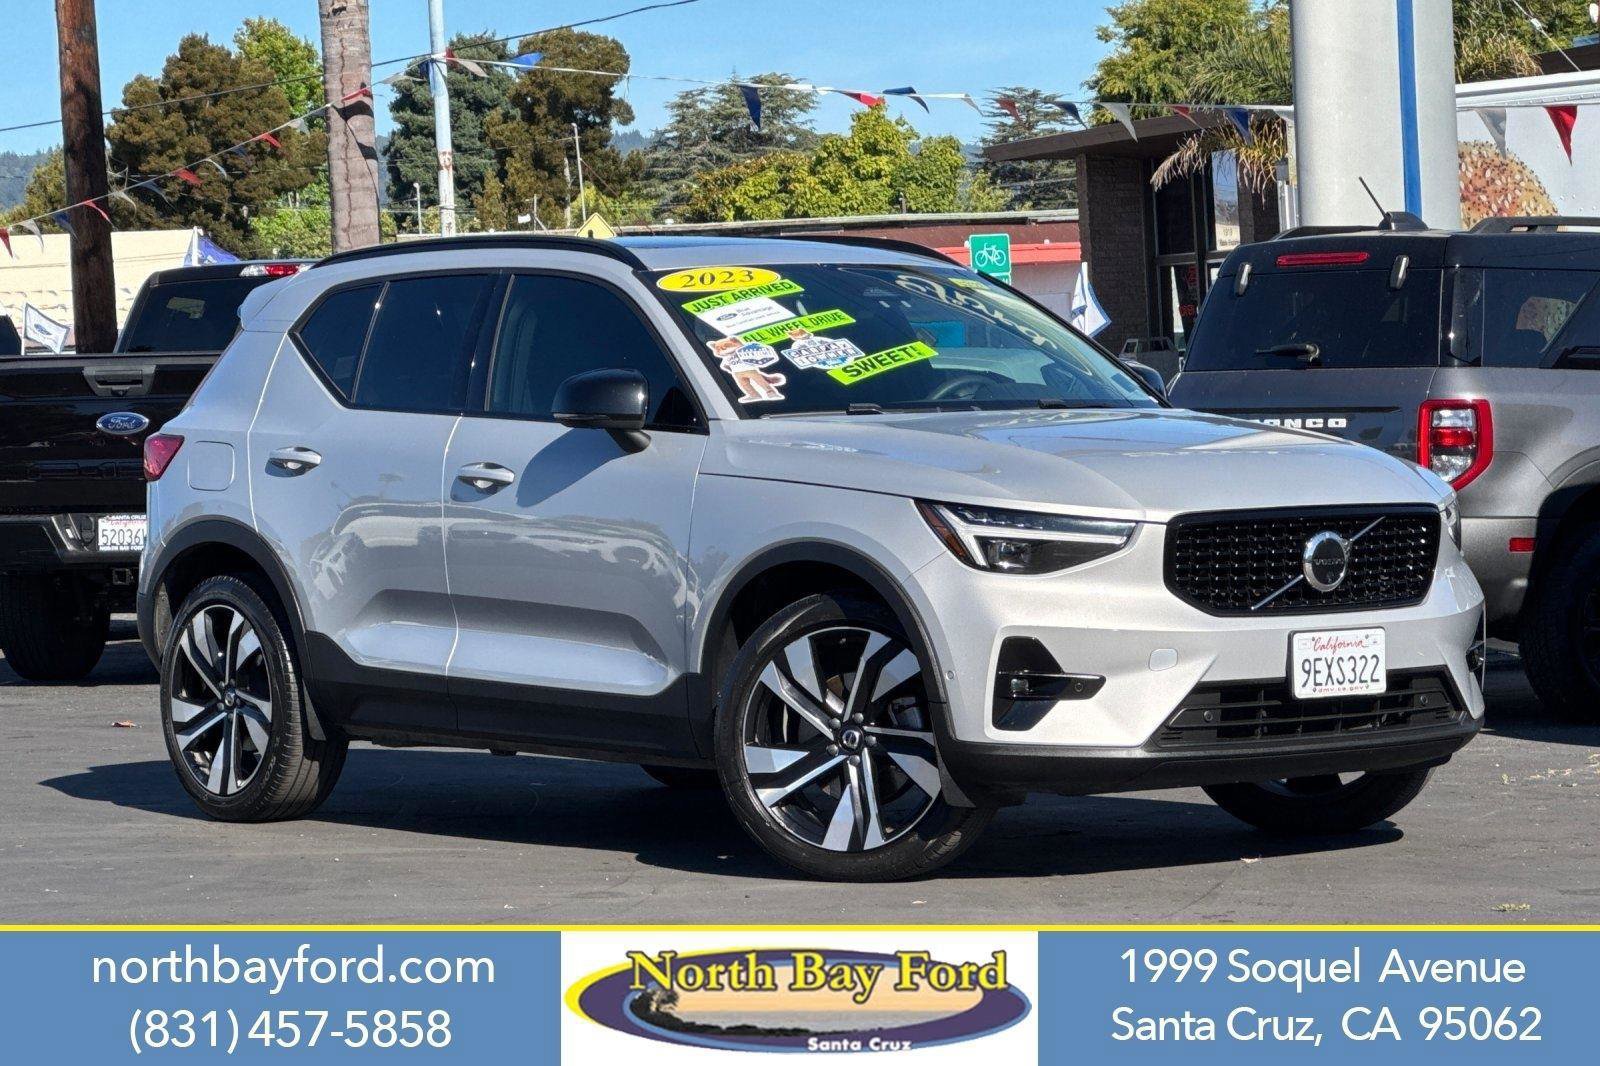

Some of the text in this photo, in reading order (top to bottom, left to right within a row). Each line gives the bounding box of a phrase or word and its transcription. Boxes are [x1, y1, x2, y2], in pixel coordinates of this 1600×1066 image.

[680, 269, 754, 288] 2023
[692, 281, 794, 313] JUST ARRIVED
[742, 330, 768, 343] ALL
[766, 319, 811, 337] WHEEL
[809, 312, 846, 326] DRIVE
[842, 345, 925, 377] SWEET!
[108, 416, 136, 430] Ford
[102, 529, 145, 545] 52036
[1313, 635, 1369, 655] California
[1301, 654, 1380, 688] 9EXS322
